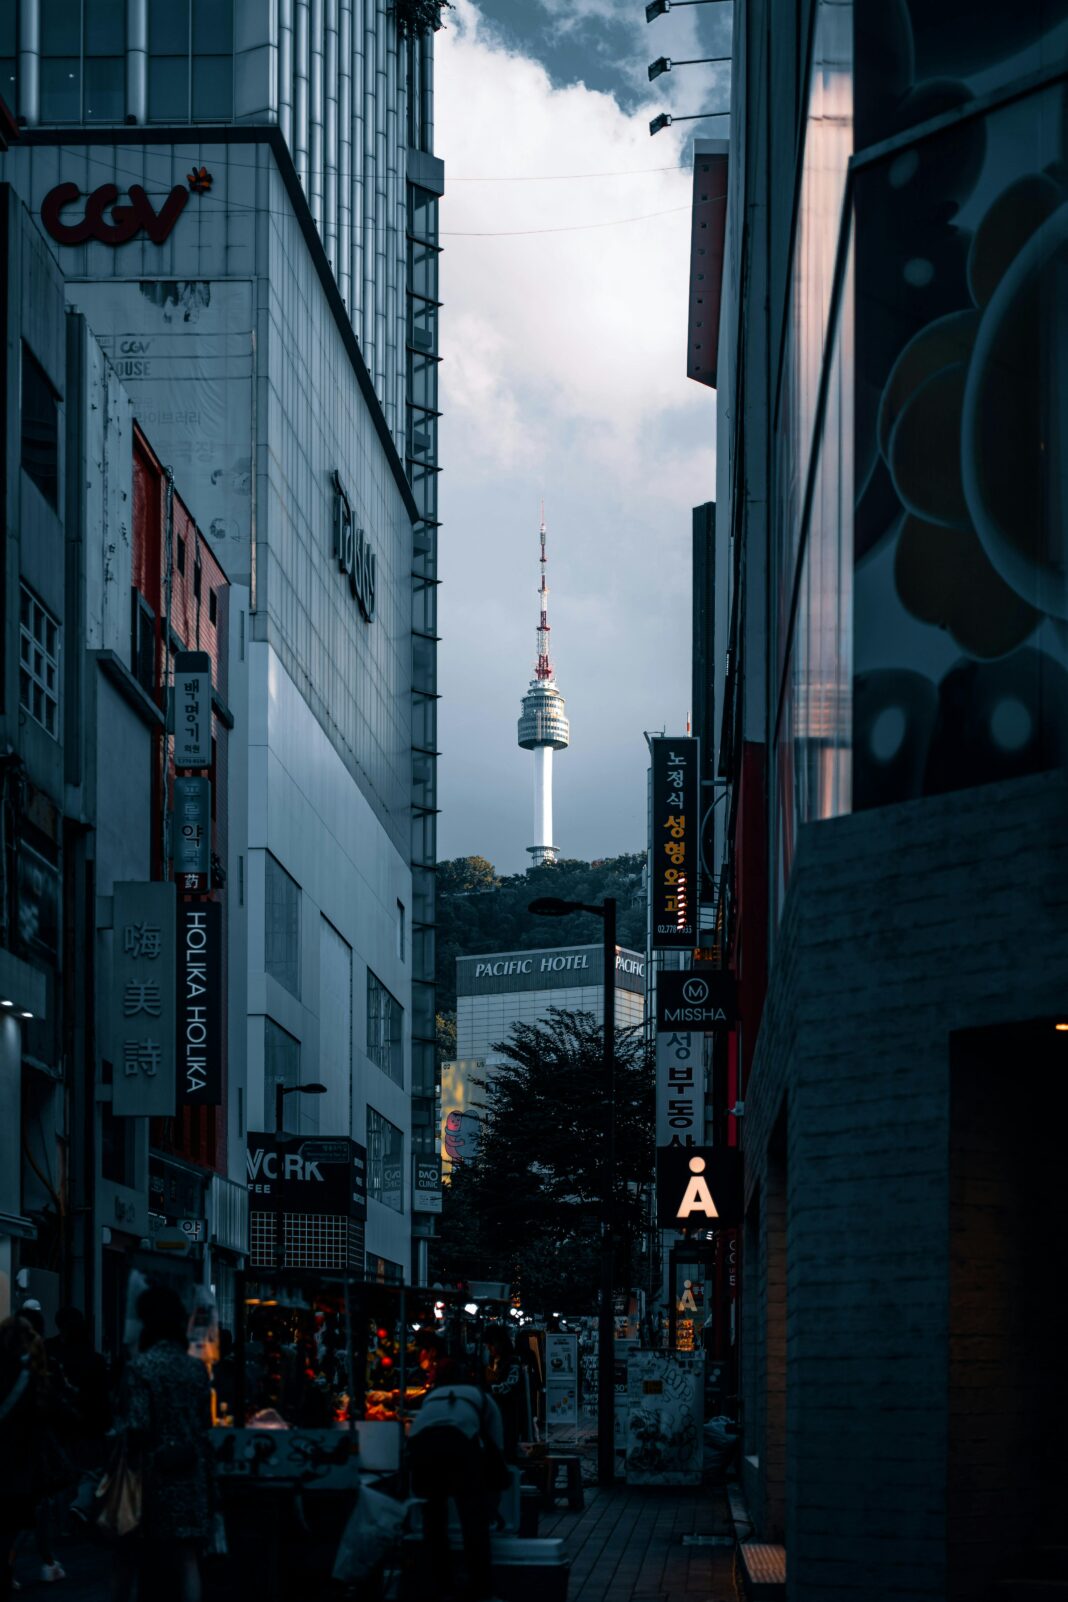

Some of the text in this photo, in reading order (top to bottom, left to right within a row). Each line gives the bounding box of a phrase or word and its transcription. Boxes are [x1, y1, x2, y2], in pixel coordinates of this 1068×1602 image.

[41, 182, 189, 245] CGV
[120, 341, 149, 354] CGV
[184, 679, 199, 742] 백명기
[666, 752, 687, 809] 노정식
[475, 954, 589, 978] PACIFIC HOTEL
[615, 956, 645, 978] PACIFIC
[123, 920, 162, 1078] 嗨美詩
[186, 911, 208, 1094] HOLIKA HOLIKA
[664, 1008, 728, 1022] MISSHA
